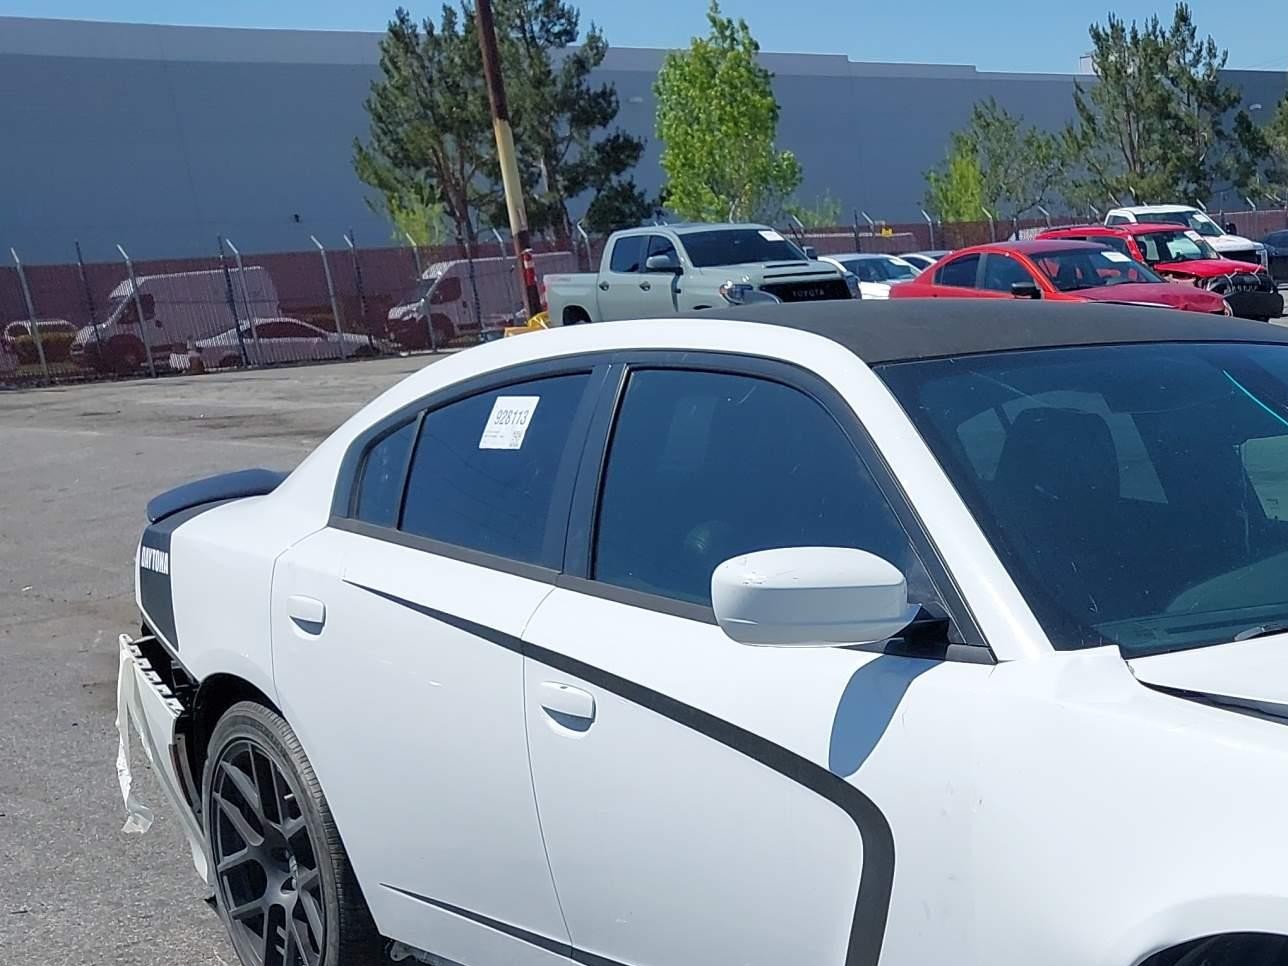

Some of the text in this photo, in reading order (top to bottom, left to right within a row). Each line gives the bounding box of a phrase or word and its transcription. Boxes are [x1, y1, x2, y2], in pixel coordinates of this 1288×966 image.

[792, 288, 825, 297] TOYOTA
[494, 409, 530, 425] 928113
[141, 546, 169, 575] DAYTONA
